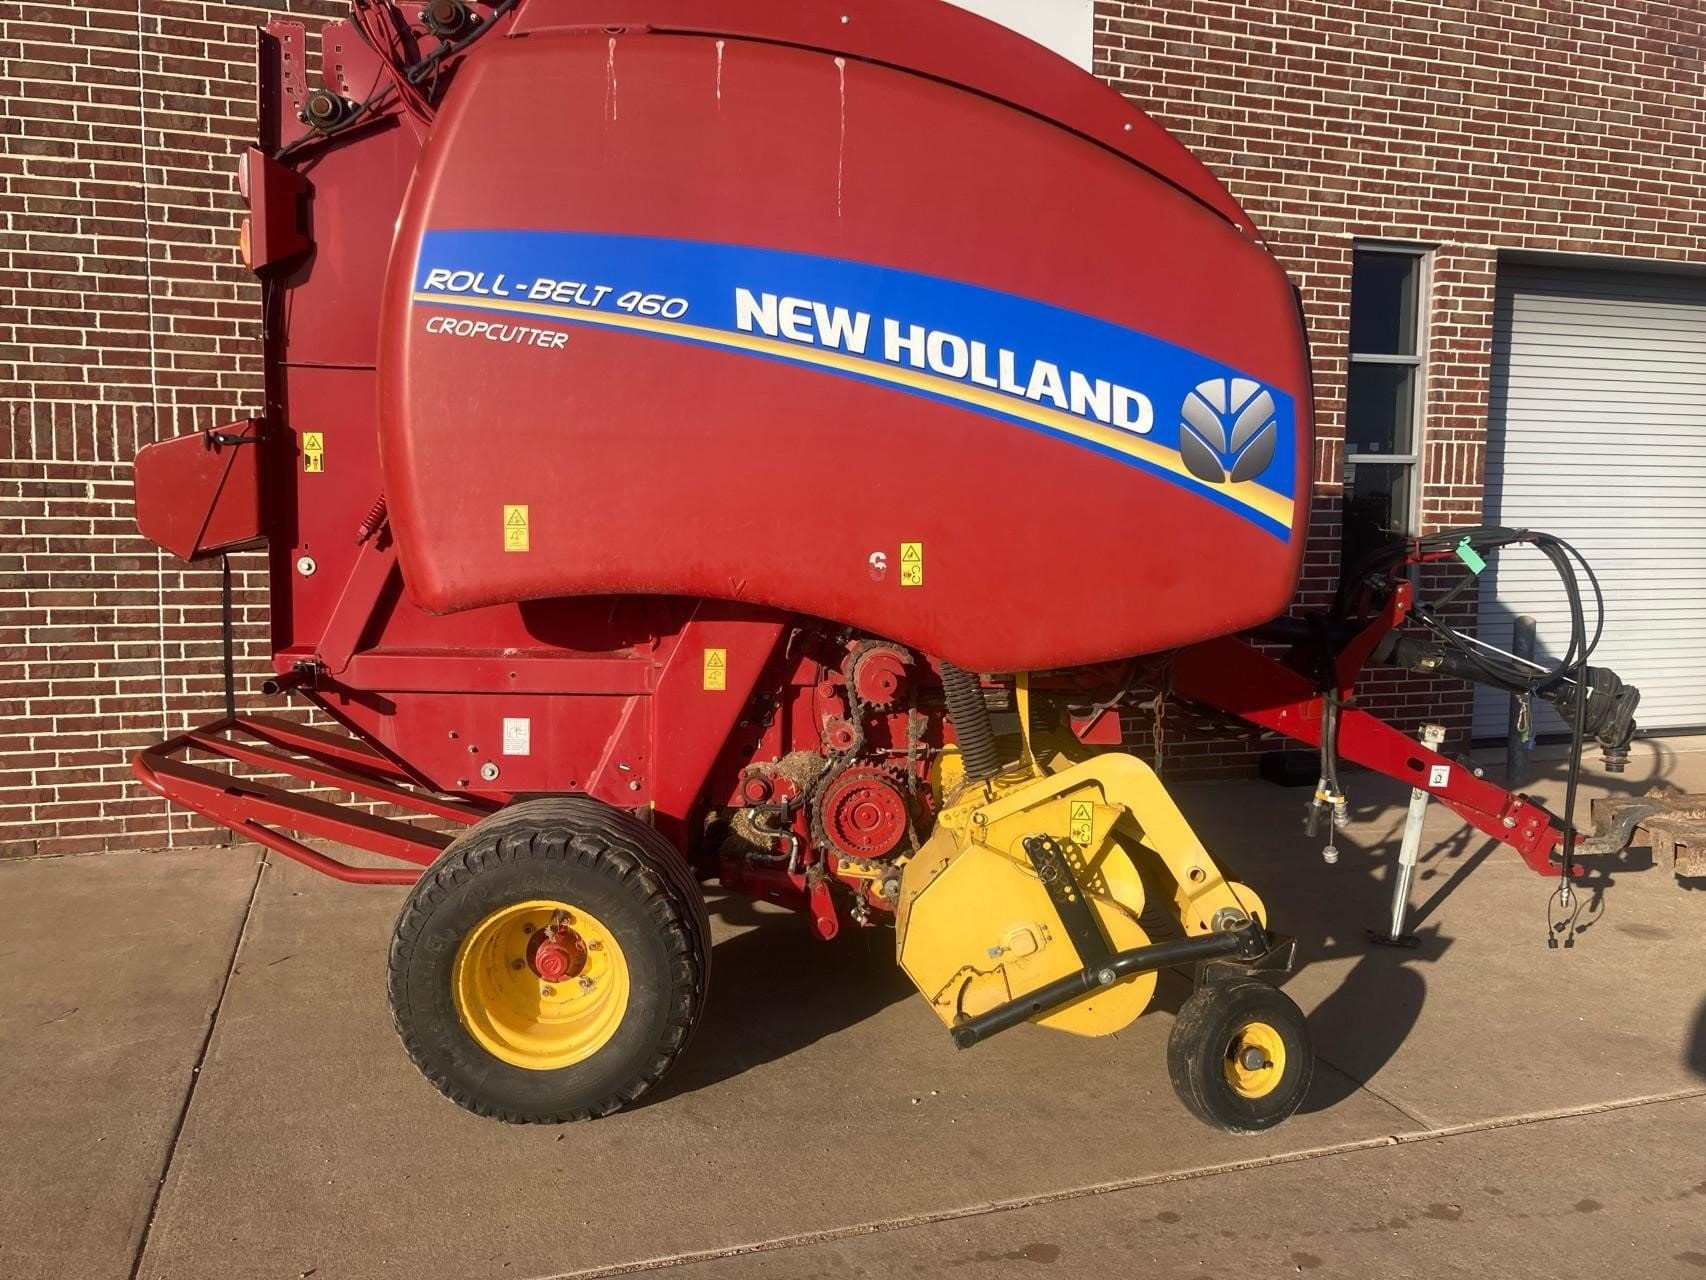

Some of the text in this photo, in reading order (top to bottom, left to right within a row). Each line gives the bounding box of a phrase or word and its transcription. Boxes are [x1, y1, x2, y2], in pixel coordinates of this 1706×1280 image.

[616, 291, 689, 319] 460
[426, 316, 570, 349] CROPCUTTER
[735, 287, 1155, 435] NEW HOLLAND
